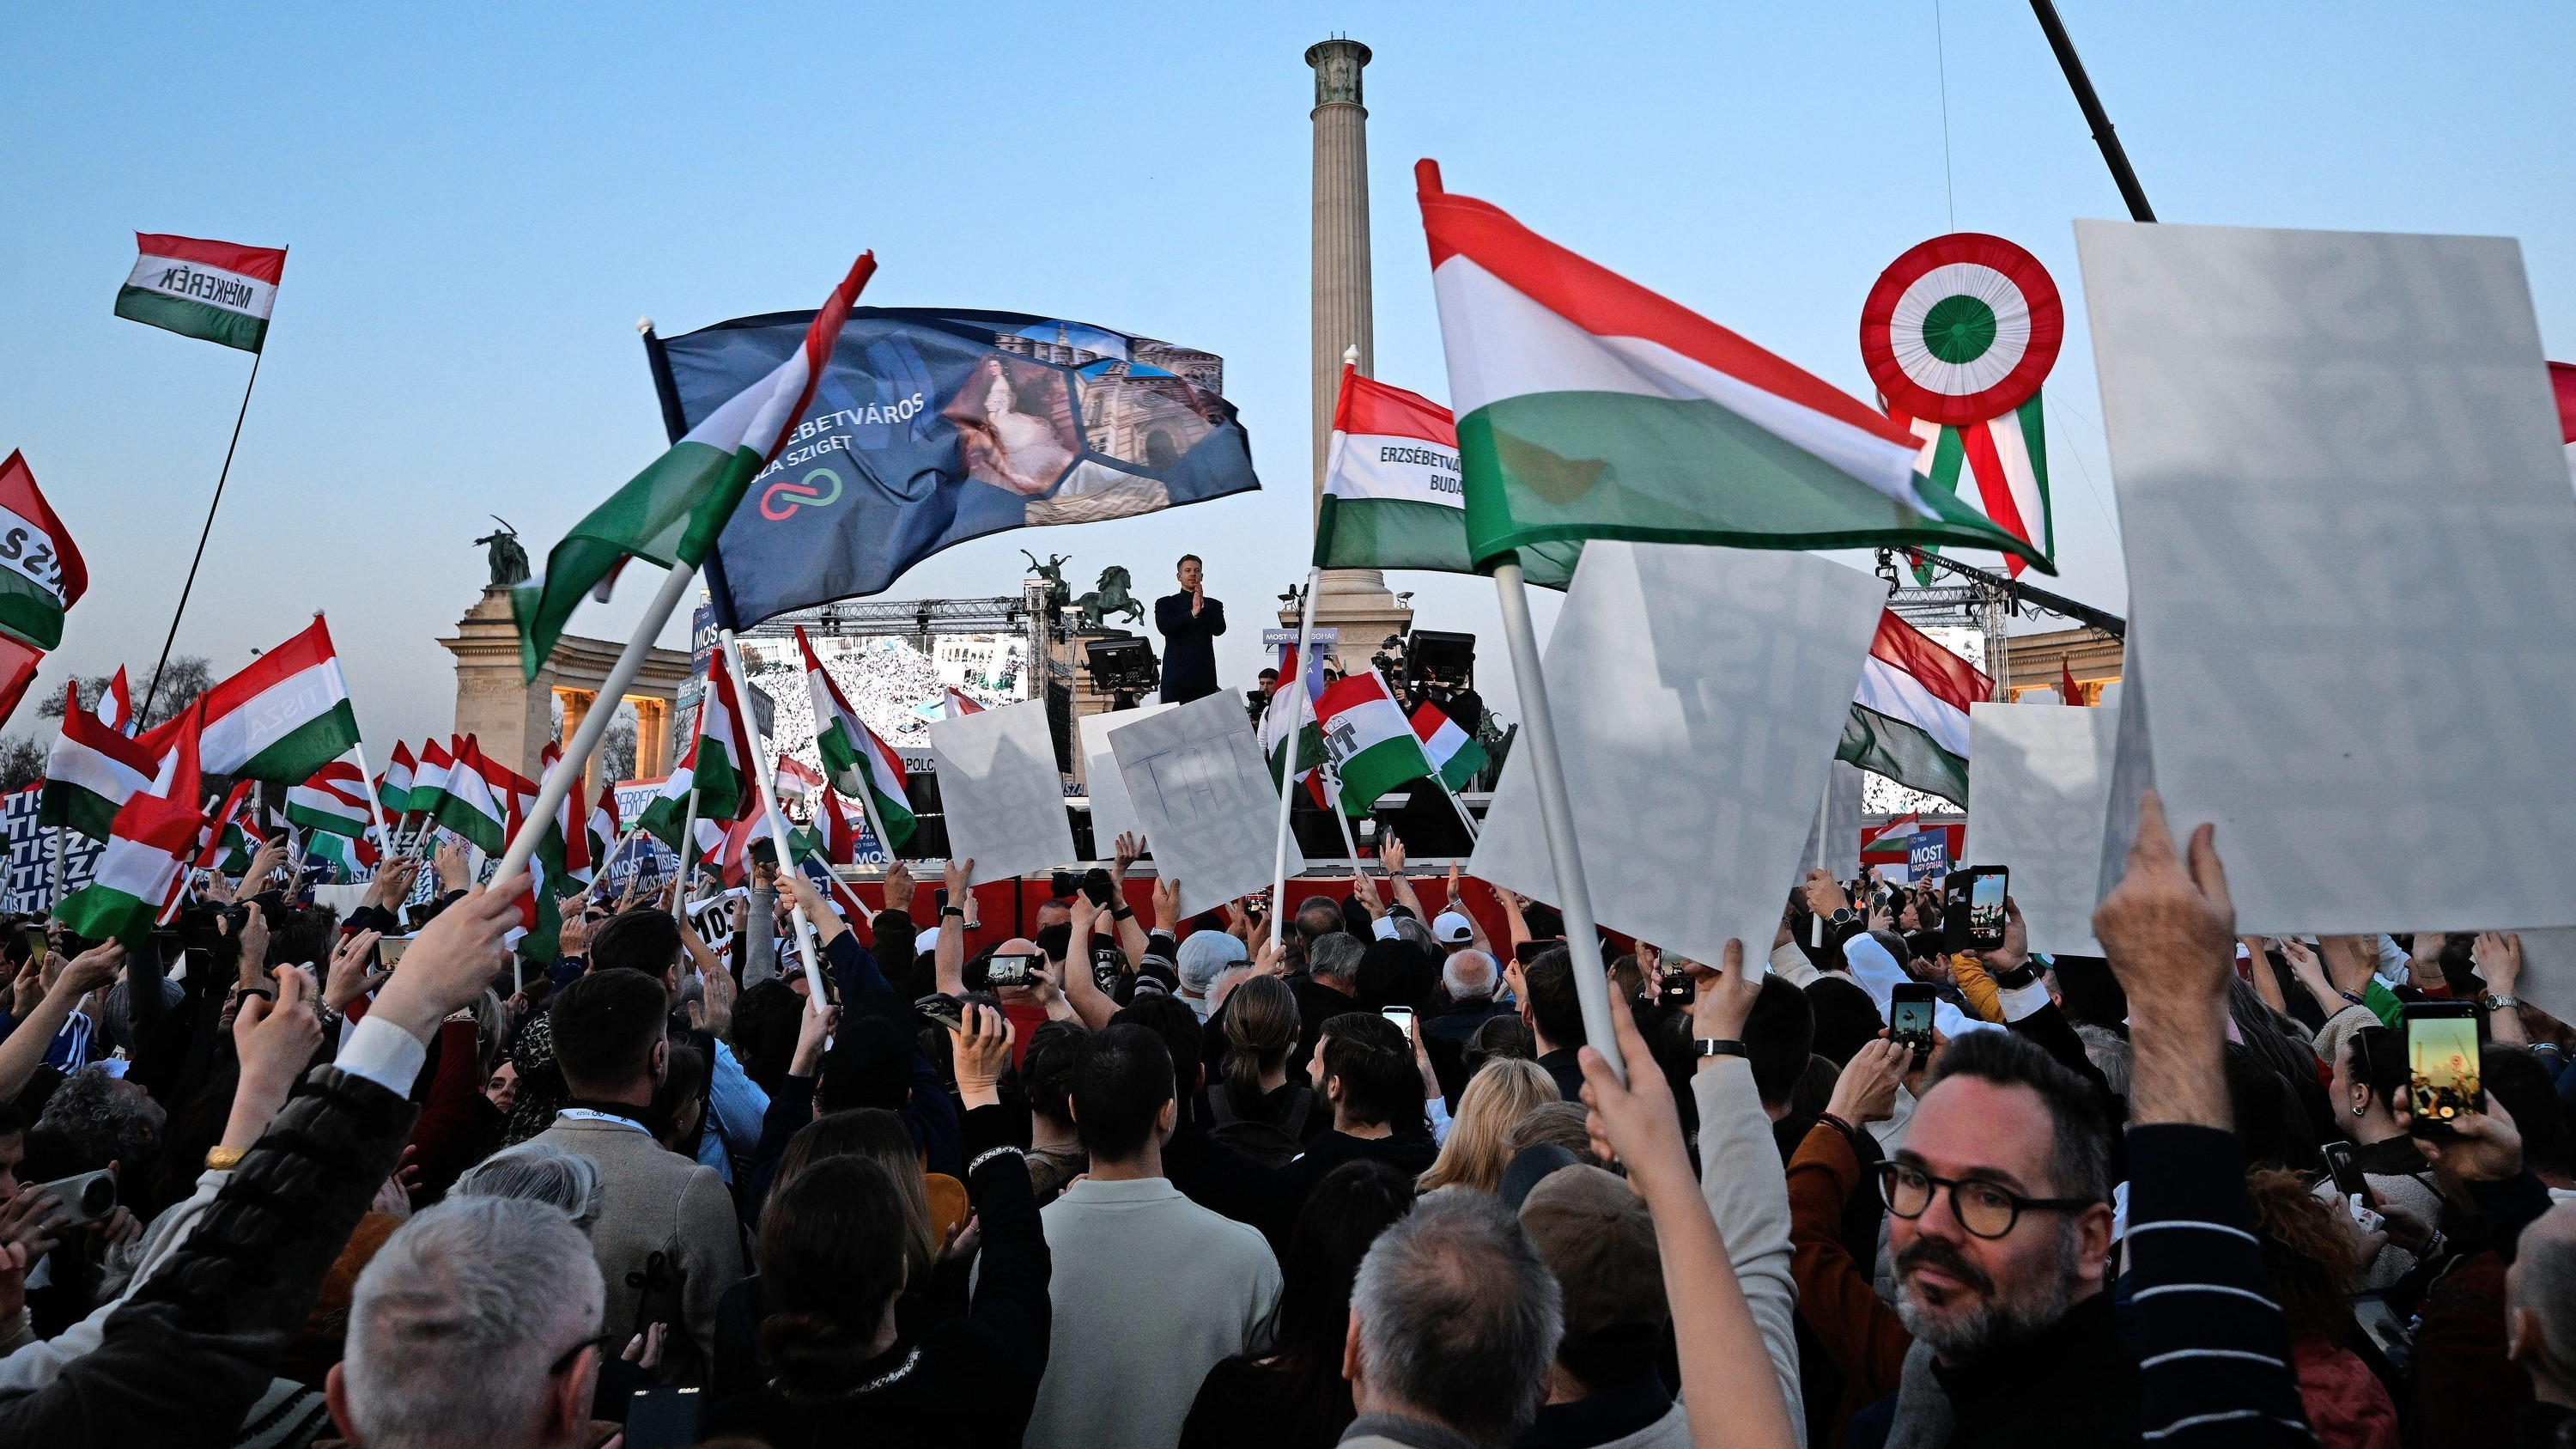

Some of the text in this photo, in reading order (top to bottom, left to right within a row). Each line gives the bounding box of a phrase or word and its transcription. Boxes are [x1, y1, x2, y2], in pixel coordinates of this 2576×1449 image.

[786, 435, 853, 466] SZIGET
[1911, 844, 1943, 864] MOST
[611, 856, 644, 878] MOST
